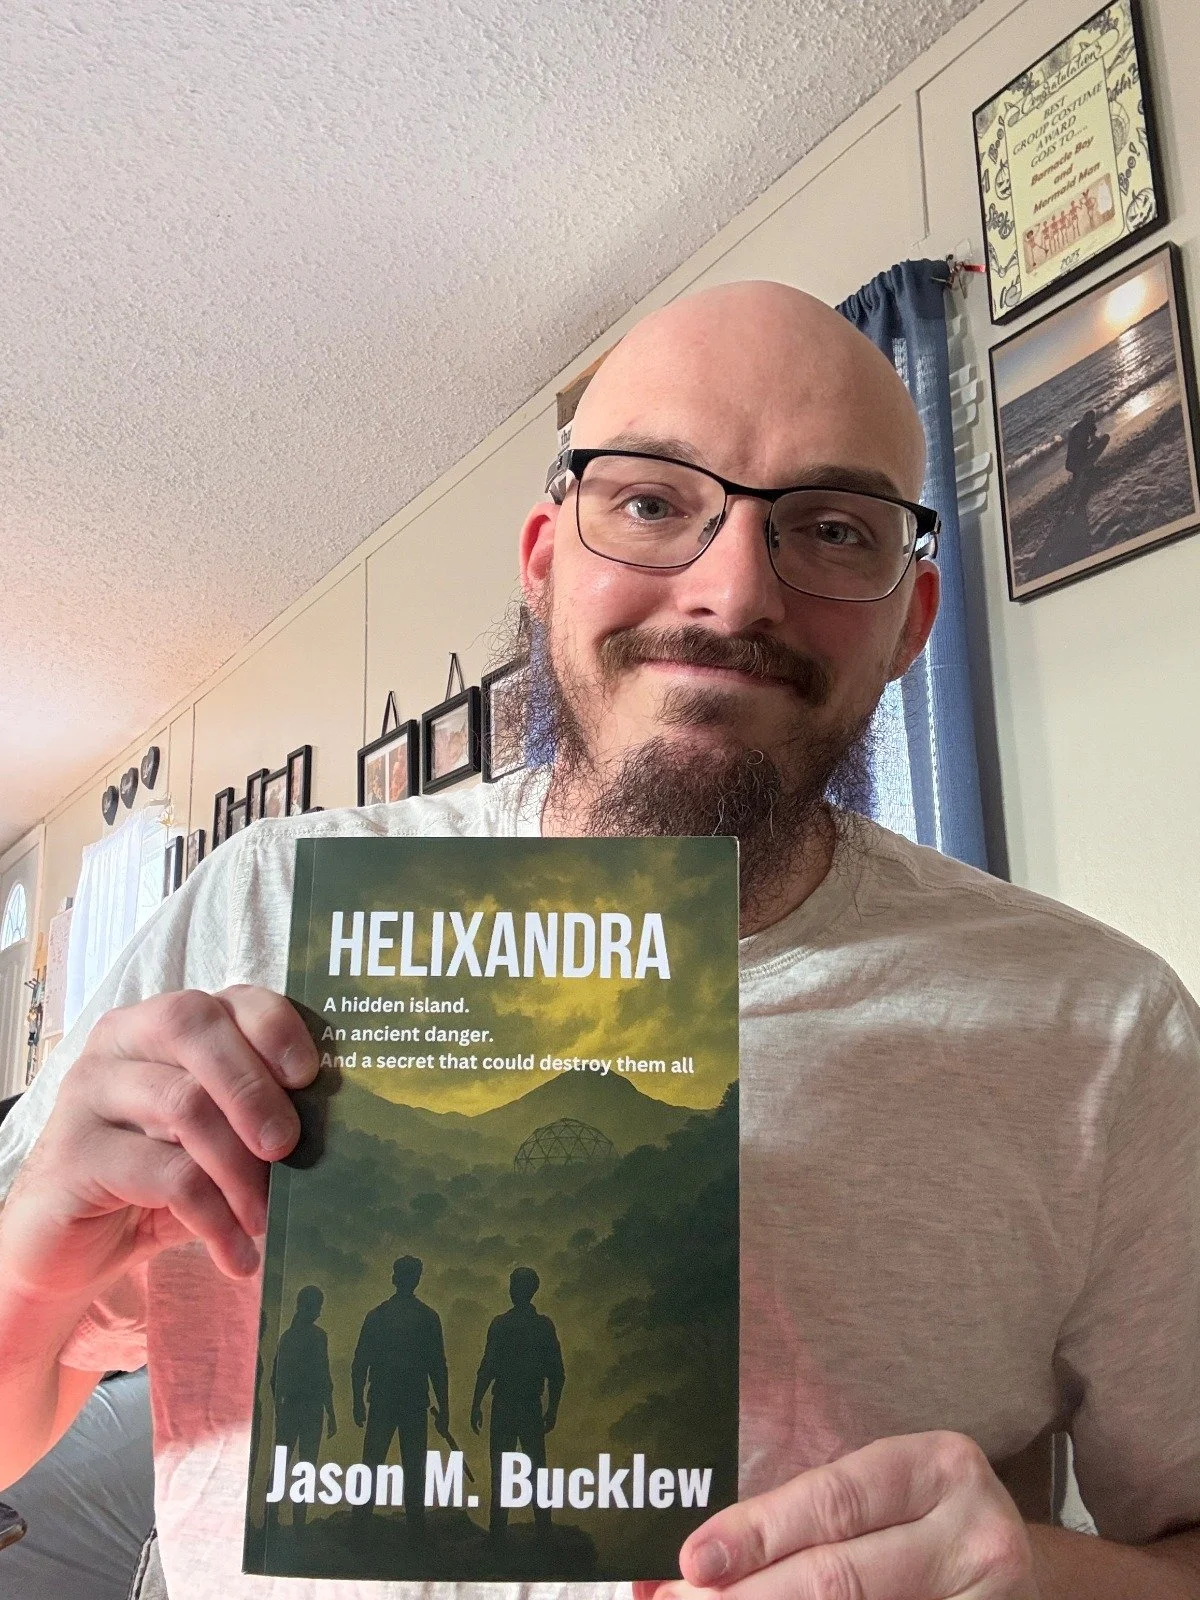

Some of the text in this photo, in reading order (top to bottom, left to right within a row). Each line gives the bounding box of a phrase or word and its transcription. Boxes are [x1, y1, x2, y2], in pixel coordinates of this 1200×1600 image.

[1013, 122, 1049, 155] GROUP
[1052, 80, 1103, 126] COSTUME
[1043, 94, 1067, 119] BEST
[1036, 115, 1077, 151] AWARD
[1031, 142, 1057, 167] GOES
[1031, 136, 1094, 186] Barnacle Boy
[1033, 162, 1100, 214] Mermaid Man
[1054, 163, 1073, 184] and
[328, 911, 671, 980] HELIXANDRA
[323, 995, 470, 1014] A hidden island.
[321, 1025, 494, 1048] An ancient danger.
[320, 1053, 695, 1076] And a secret that could destroy them all
[266, 1446, 713, 1509] Jason M. Bucklew
